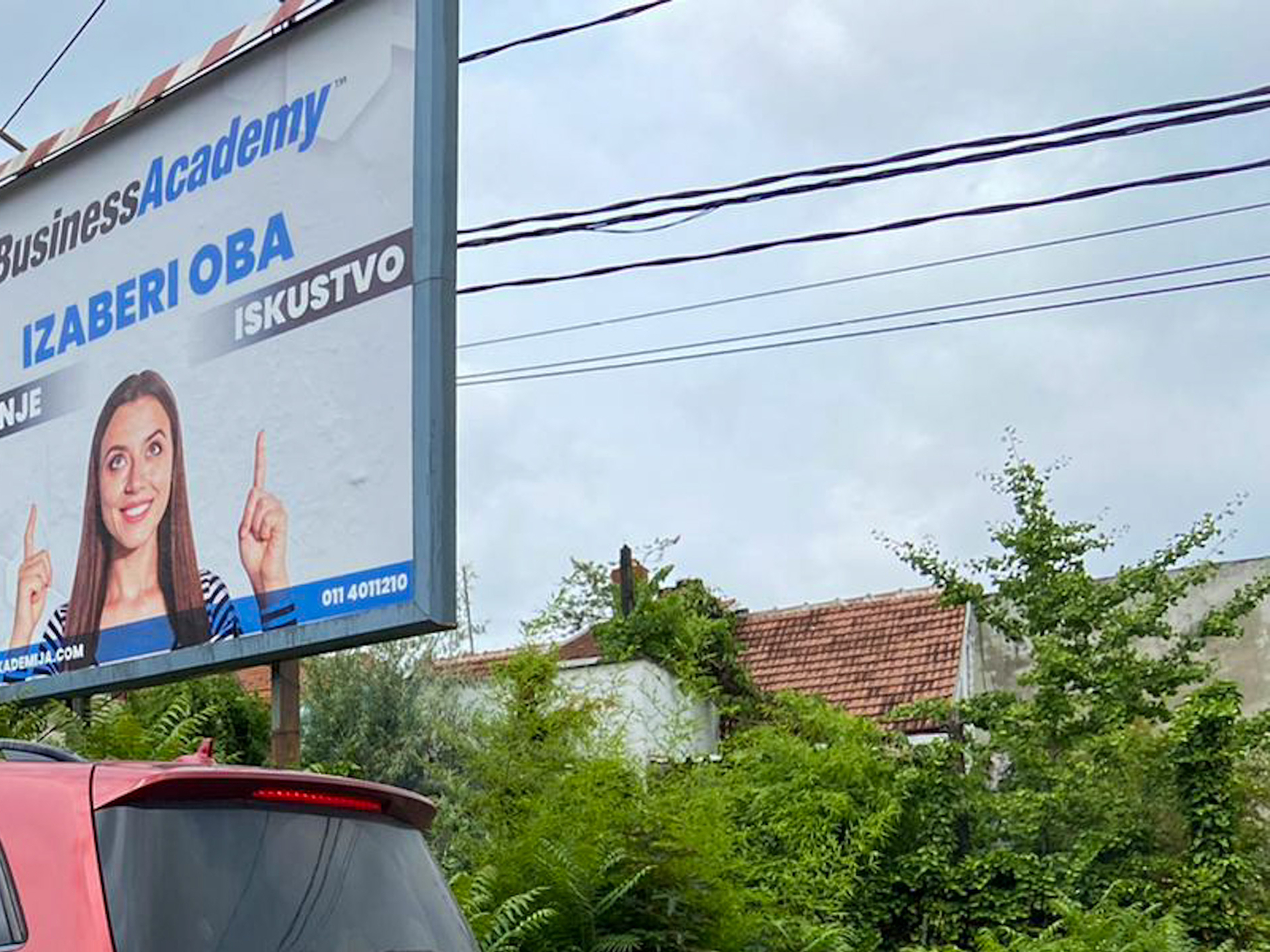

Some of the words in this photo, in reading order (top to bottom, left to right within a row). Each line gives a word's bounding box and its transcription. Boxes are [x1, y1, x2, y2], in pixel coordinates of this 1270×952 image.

[23, 259, 179, 369] IZABERI
[188, 212, 295, 297] OBA
[234, 244, 406, 341] ISKUSTVO
[322, 586, 344, 606] 011
[347, 573, 408, 601] 4011210
